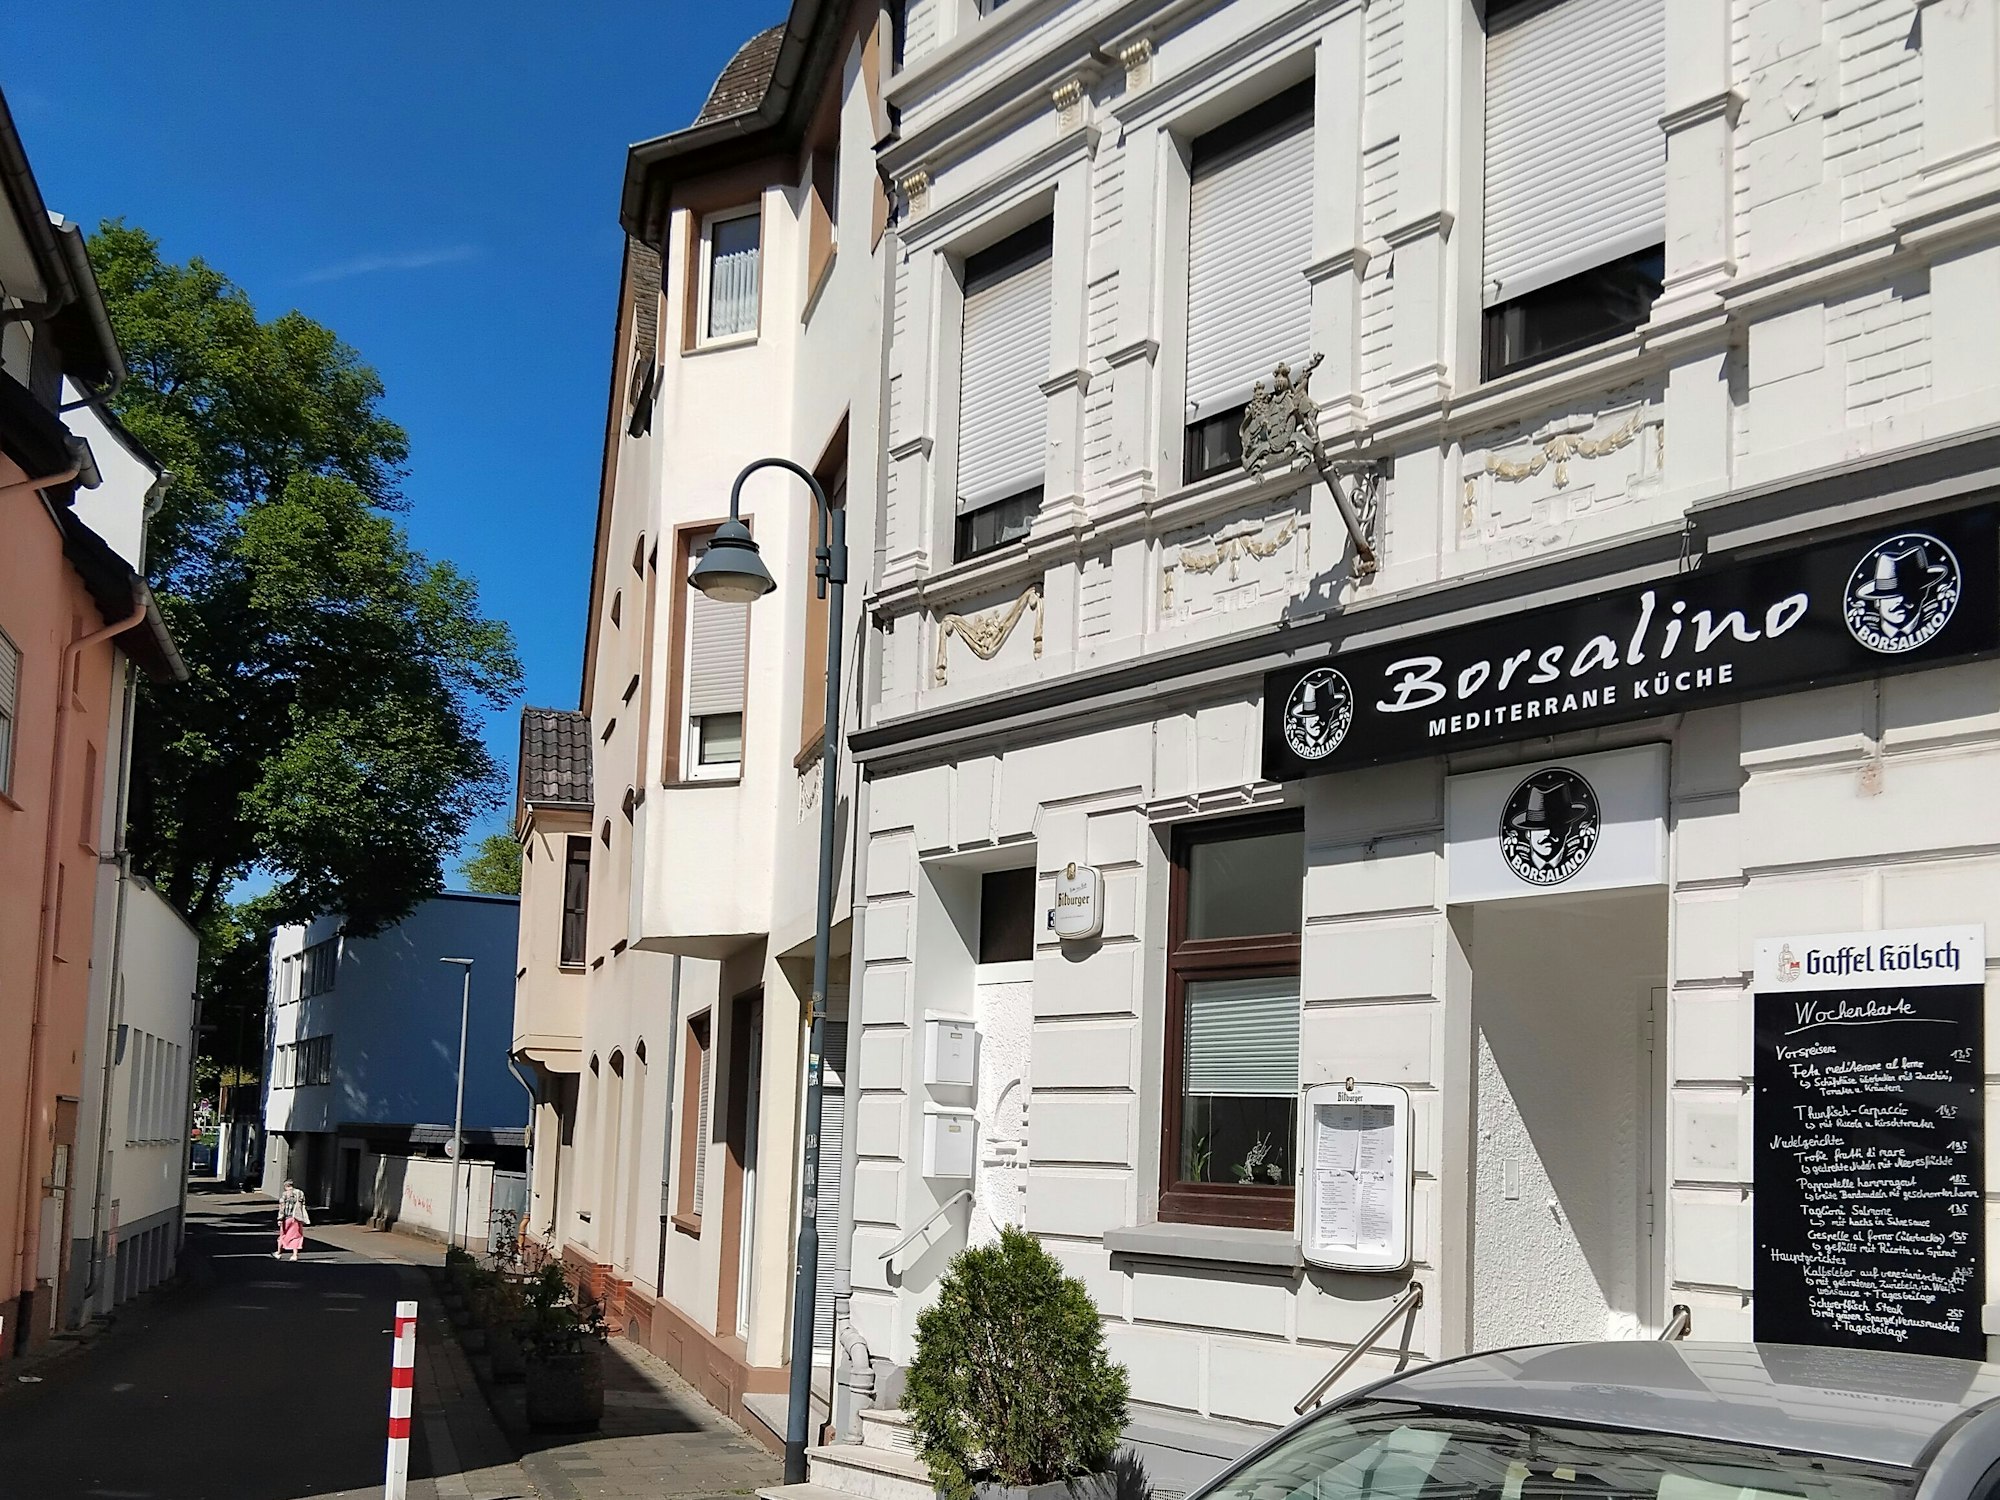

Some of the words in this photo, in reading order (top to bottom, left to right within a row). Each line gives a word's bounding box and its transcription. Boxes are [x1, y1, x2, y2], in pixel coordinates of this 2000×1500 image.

[1857, 613, 1945, 650] BORSALINO
[1376, 591, 1809, 713] Borsalino
[1429, 686, 1616, 737] MEDITERRANE
[1634, 664, 1733, 699] KÜCHE
[1291, 729, 1343, 757] BORSALINO
[1512, 849, 1586, 882] BORSALINO
[1058, 892, 1090, 907] Bitburger
[1807, 946, 1875, 975] Gaffel
[1880, 941, 1960, 972] Kölsch
[1795, 998, 1917, 1025] Wochenkarte
[1789, 1063, 1821, 1078] Feta
[1885, 1058, 1899, 1069] al
